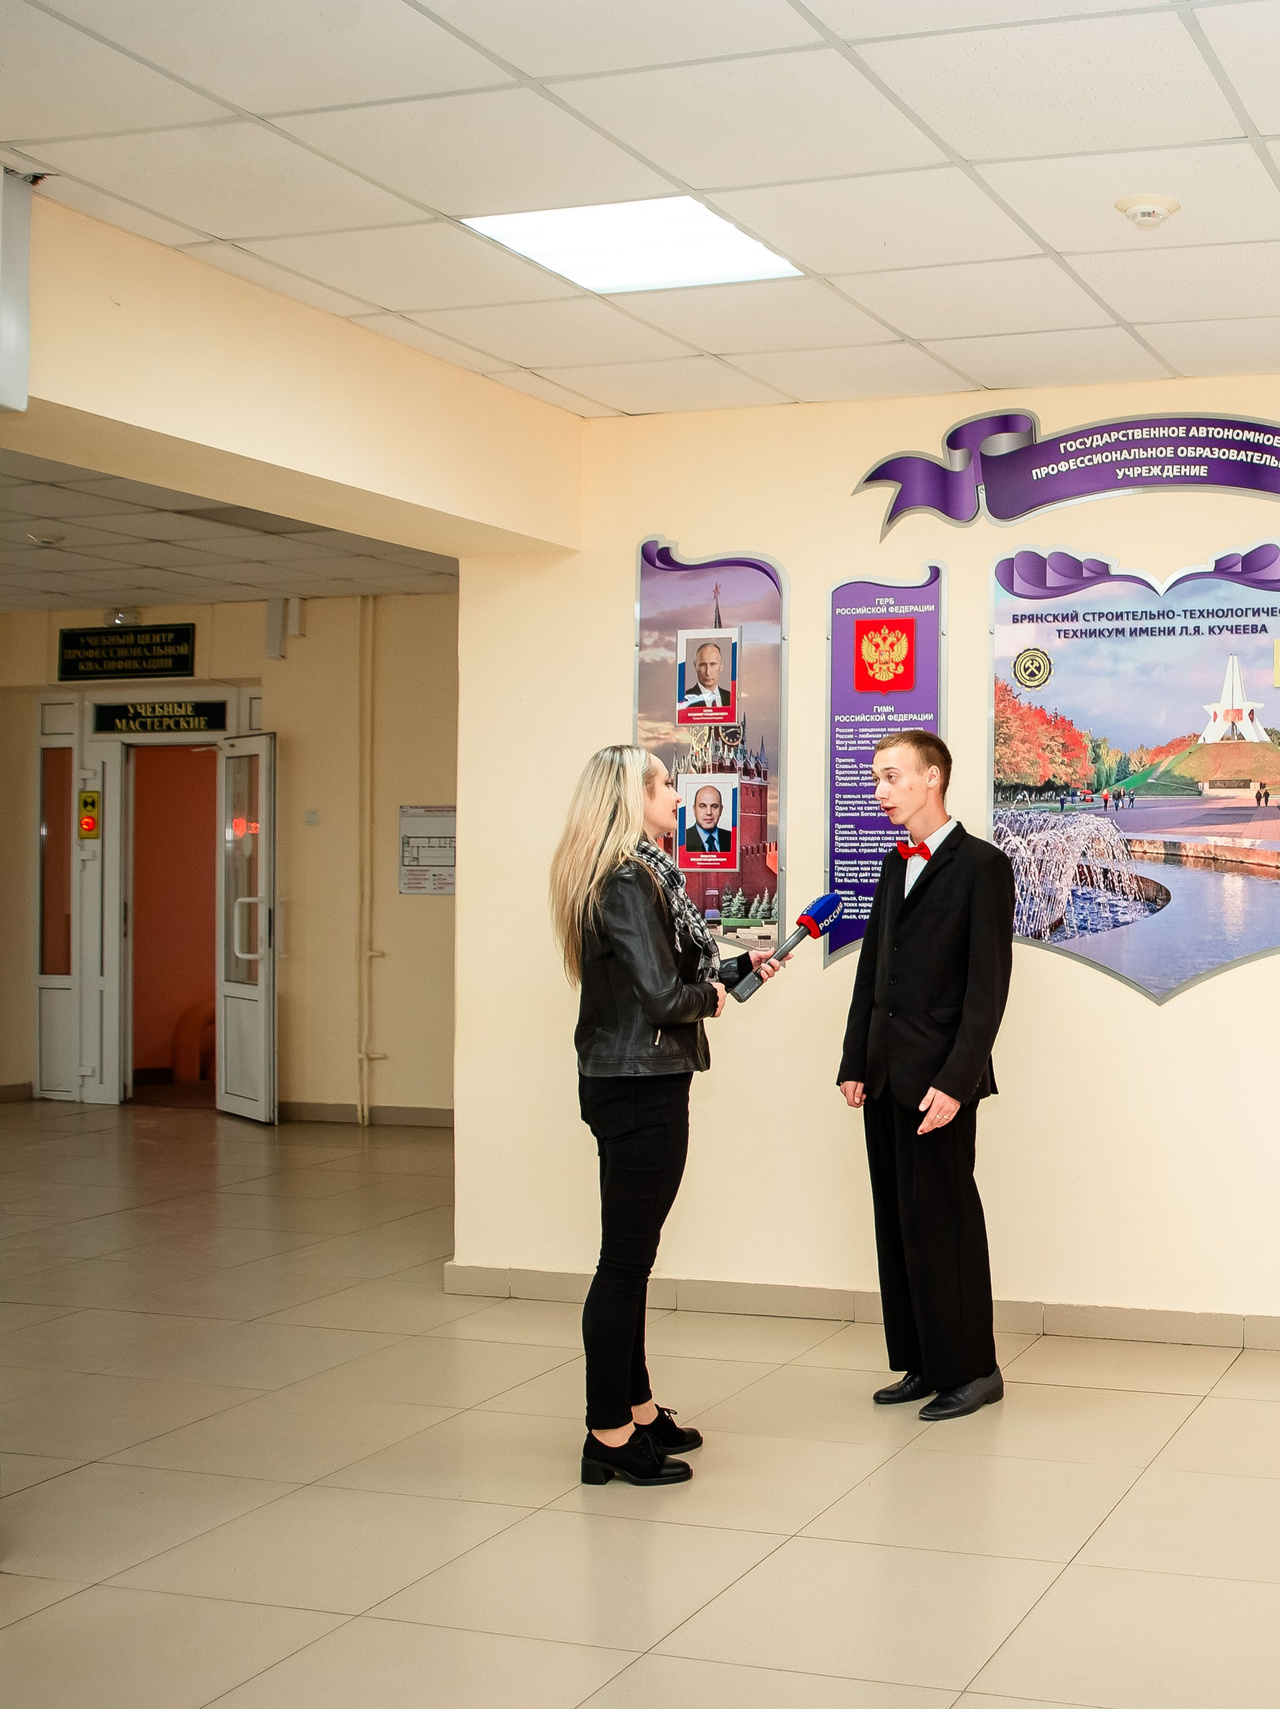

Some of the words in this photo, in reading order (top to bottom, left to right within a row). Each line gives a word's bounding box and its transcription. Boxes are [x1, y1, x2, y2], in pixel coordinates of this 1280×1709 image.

[1059, 426, 1187, 454] ГОСУДАРСТВЕННОЕ
[1031, 446, 1175, 481] ПРОФЕССИОНАЛЬНОЕ
[1115, 465, 1209, 479] УЧРЕЖДЕНИЕ
[836, 606, 886, 615] РОССИЙСКОЙ
[888, 605, 934, 613] ФЕДЕРАЦИИ
[1012, 610, 1079, 624] БРЯНСКИЙ
[80, 632, 135, 646] УЧЕБНЫЙ
[137, 632, 175, 645] ЦЕНТР
[1056, 627, 1126, 639] ТЕХНИКУМ
[1128, 626, 1176, 637] ИМЕНИ
[1179, 625, 1205, 636] Л.Я.
[1207, 624, 1269, 636] КУЧЕЕВА
[64, 642, 189, 659] ПРОФЕССИОНАЛЬНОЙ
[127, 702, 196, 717] УЧЕБНЫЕ
[114, 716, 208, 731] МАСТЕРСКИЕ
[835, 713, 885, 722] РОССИЙСКОЙ
[818, 901, 844, 931] РОССИЯ
